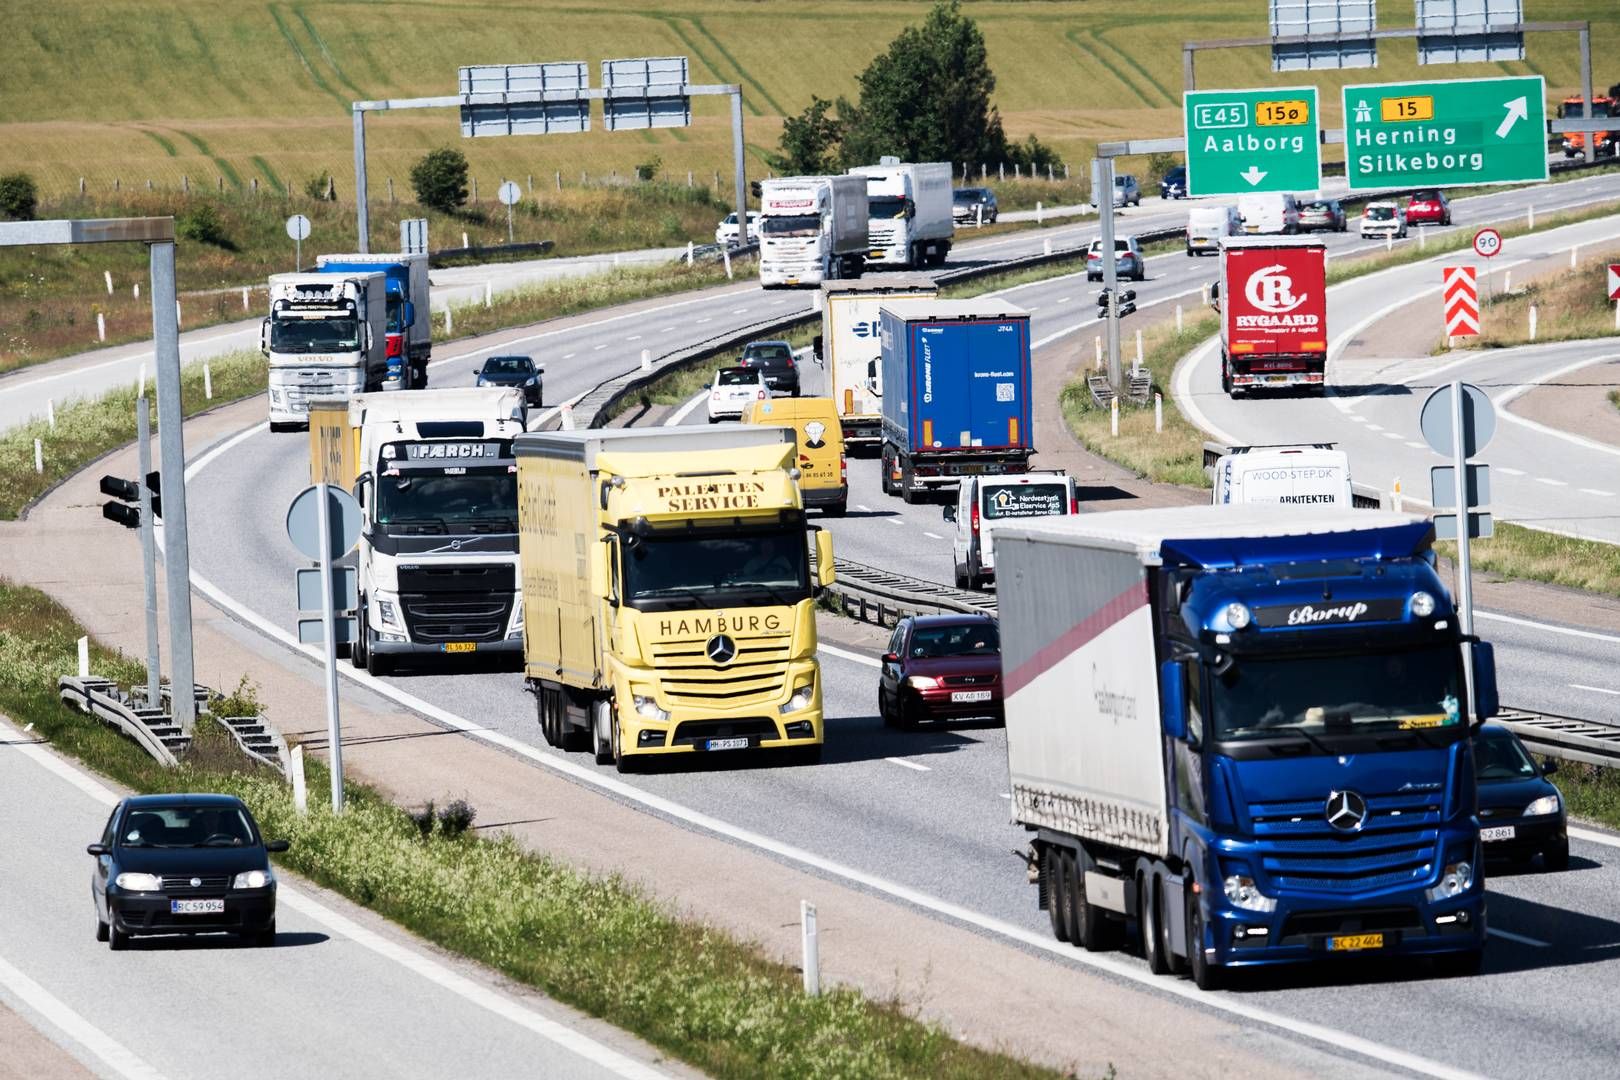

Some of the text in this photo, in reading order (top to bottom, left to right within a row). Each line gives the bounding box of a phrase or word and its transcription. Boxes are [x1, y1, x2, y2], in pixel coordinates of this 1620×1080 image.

[1201, 107, 1241, 124] E45
[1397, 101, 1417, 116] 15
[1204, 133, 1304, 153] Aalborg
[1355, 126, 1456, 146] Herning
[1358, 152, 1483, 174] Silkeborg
[1478, 237, 1497, 248] 90
[1236, 314, 1319, 327] RYGAARD
[658, 482, 765, 498] PALETTEN
[668, 495, 759, 512] SERVICE
[1279, 494, 1335, 504] ARKITEKTEN
[1287, 602, 1368, 626] Borup
[660, 615, 780, 636] HAMBURG
